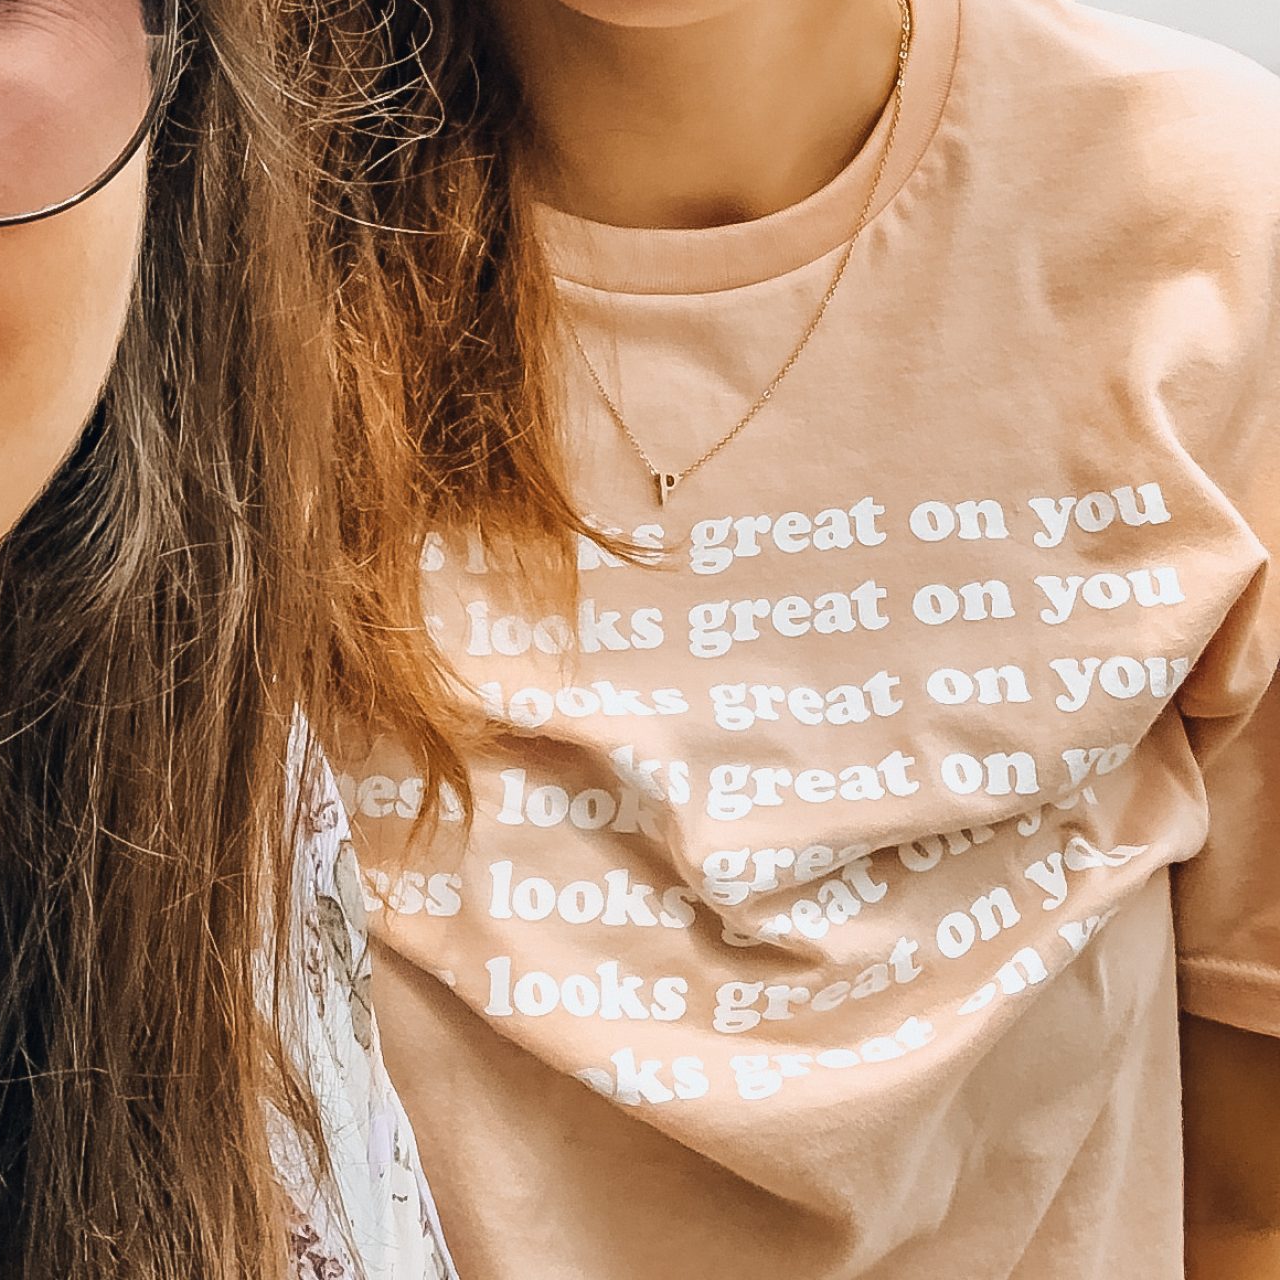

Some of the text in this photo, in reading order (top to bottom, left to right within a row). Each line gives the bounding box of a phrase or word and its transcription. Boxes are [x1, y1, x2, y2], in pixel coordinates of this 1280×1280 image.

[688, 496, 888, 575] great
[909, 499, 1010, 542] on
[1027, 482, 1171, 549] you
[465, 566, 1186, 659] looks great on you
[477, 655, 1190, 731] looks great on you
[705, 750, 920, 821] great
[940, 751, 1040, 796] on
[488, 859, 699, 929] looks
[483, 956, 689, 1021] looks
[712, 935, 923, 1034] great
[935, 886, 1022, 959] on
[728, 1015, 936, 1101] great
[955, 946, 1049, 1017] on
